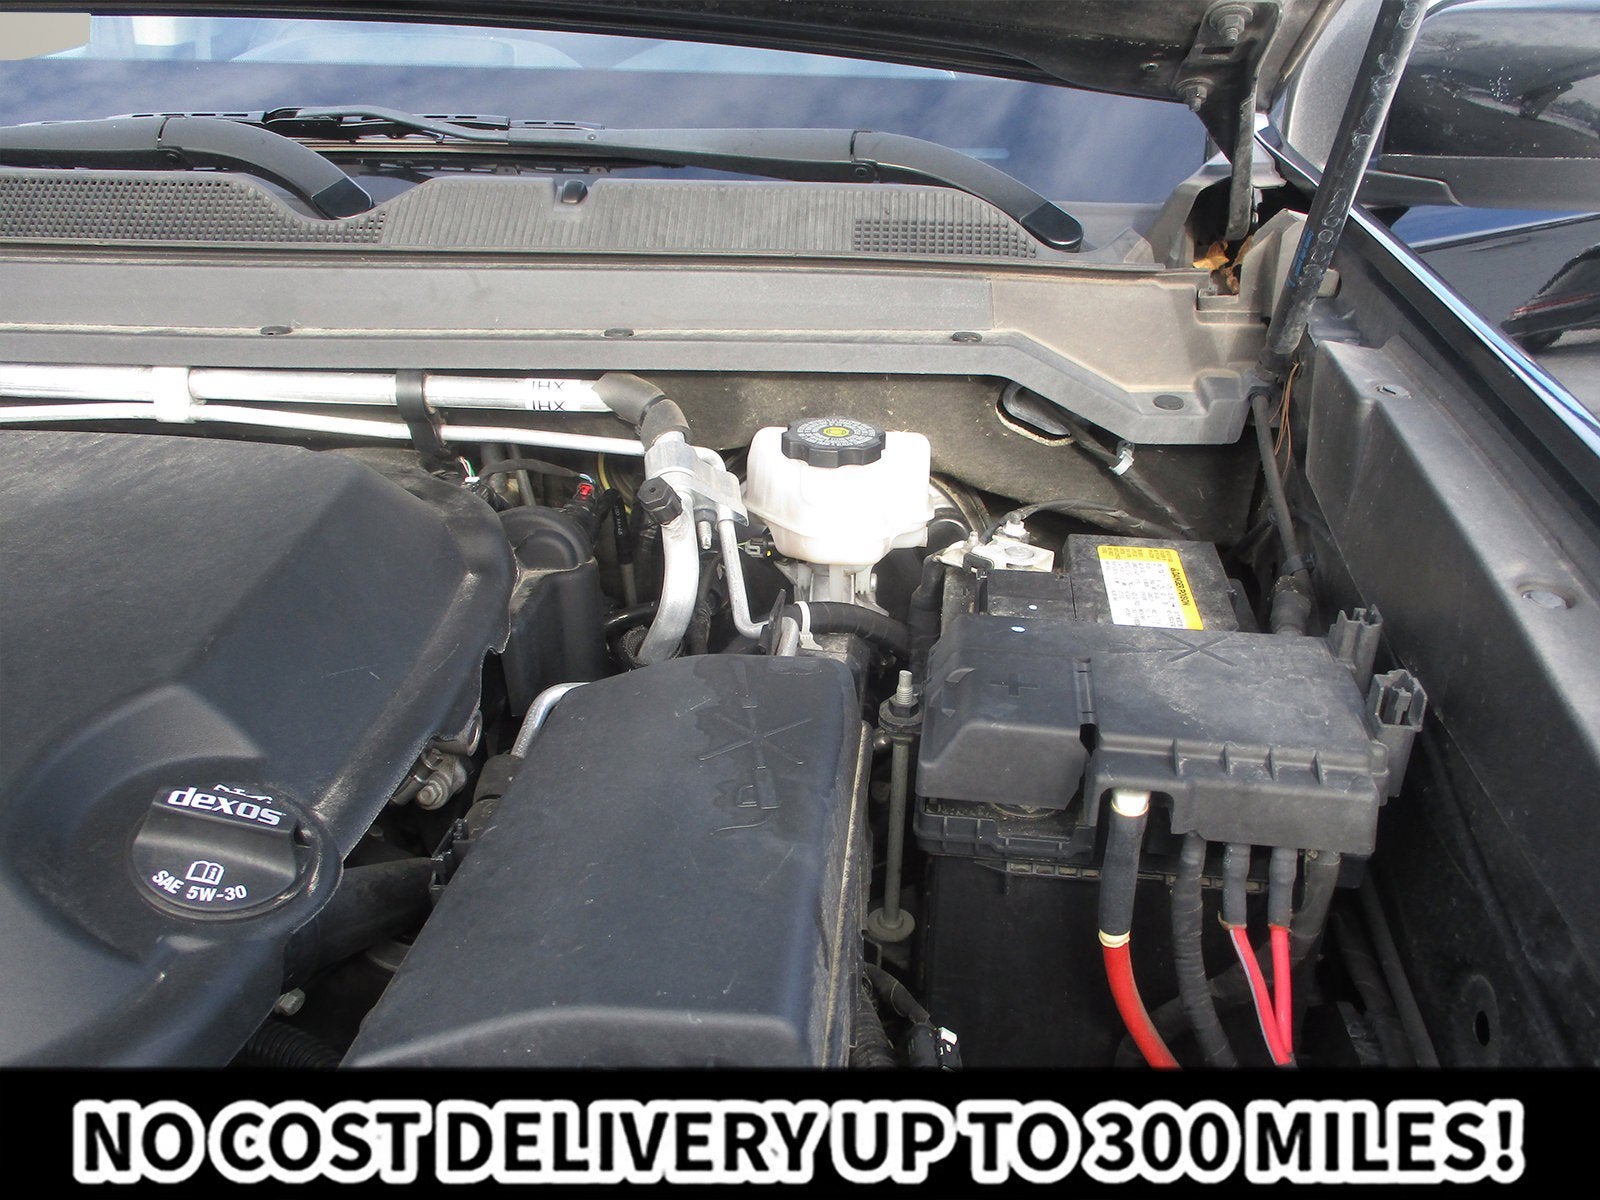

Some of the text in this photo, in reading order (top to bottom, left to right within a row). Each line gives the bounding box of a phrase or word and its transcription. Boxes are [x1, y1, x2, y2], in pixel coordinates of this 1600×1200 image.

[167, 787, 282, 826] dexos
[152, 870, 247, 901] SAE 5W-30
